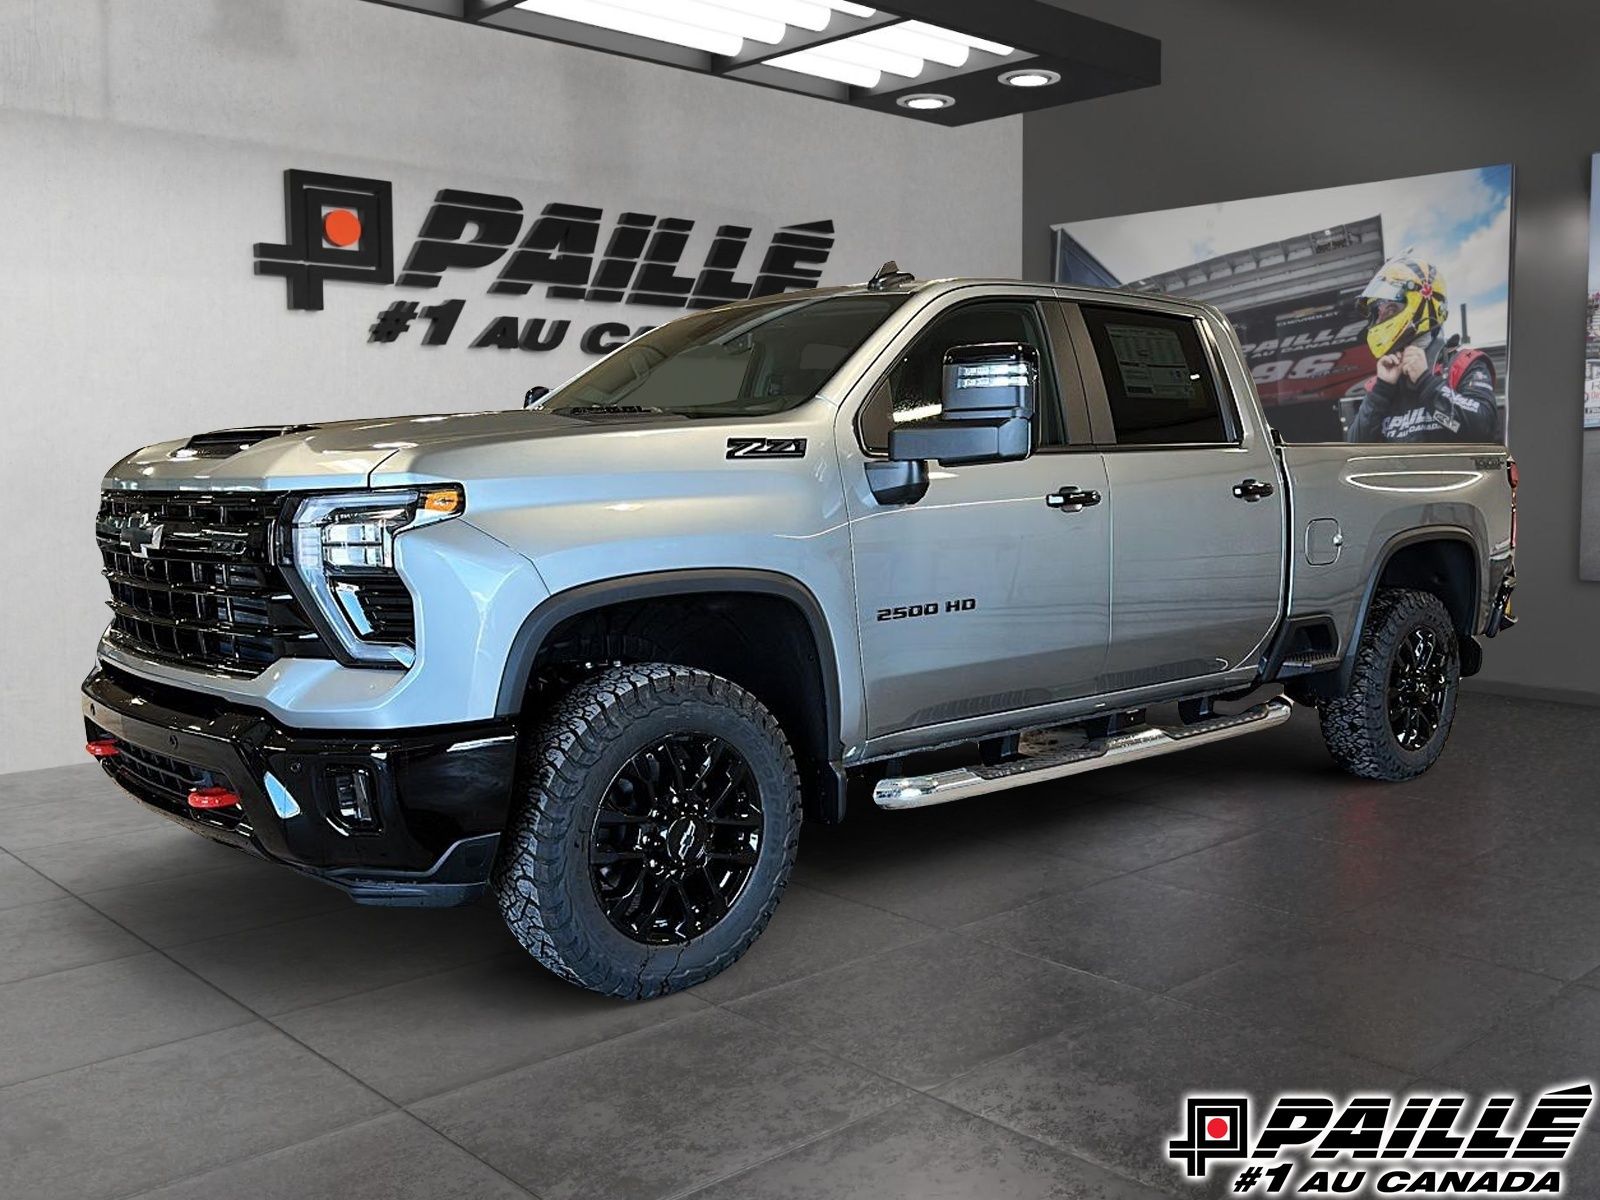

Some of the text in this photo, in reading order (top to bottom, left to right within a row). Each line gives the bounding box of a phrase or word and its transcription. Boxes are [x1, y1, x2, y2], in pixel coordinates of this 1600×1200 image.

[395, 188, 835, 309] PAILLÉ
[367, 299, 466, 346] #1
[468, 316, 571, 352] AU
[1251, 351, 1343, 384] 96
[726, 438, 807, 459] Z71
[877, 598, 975, 621] 2500 HD
